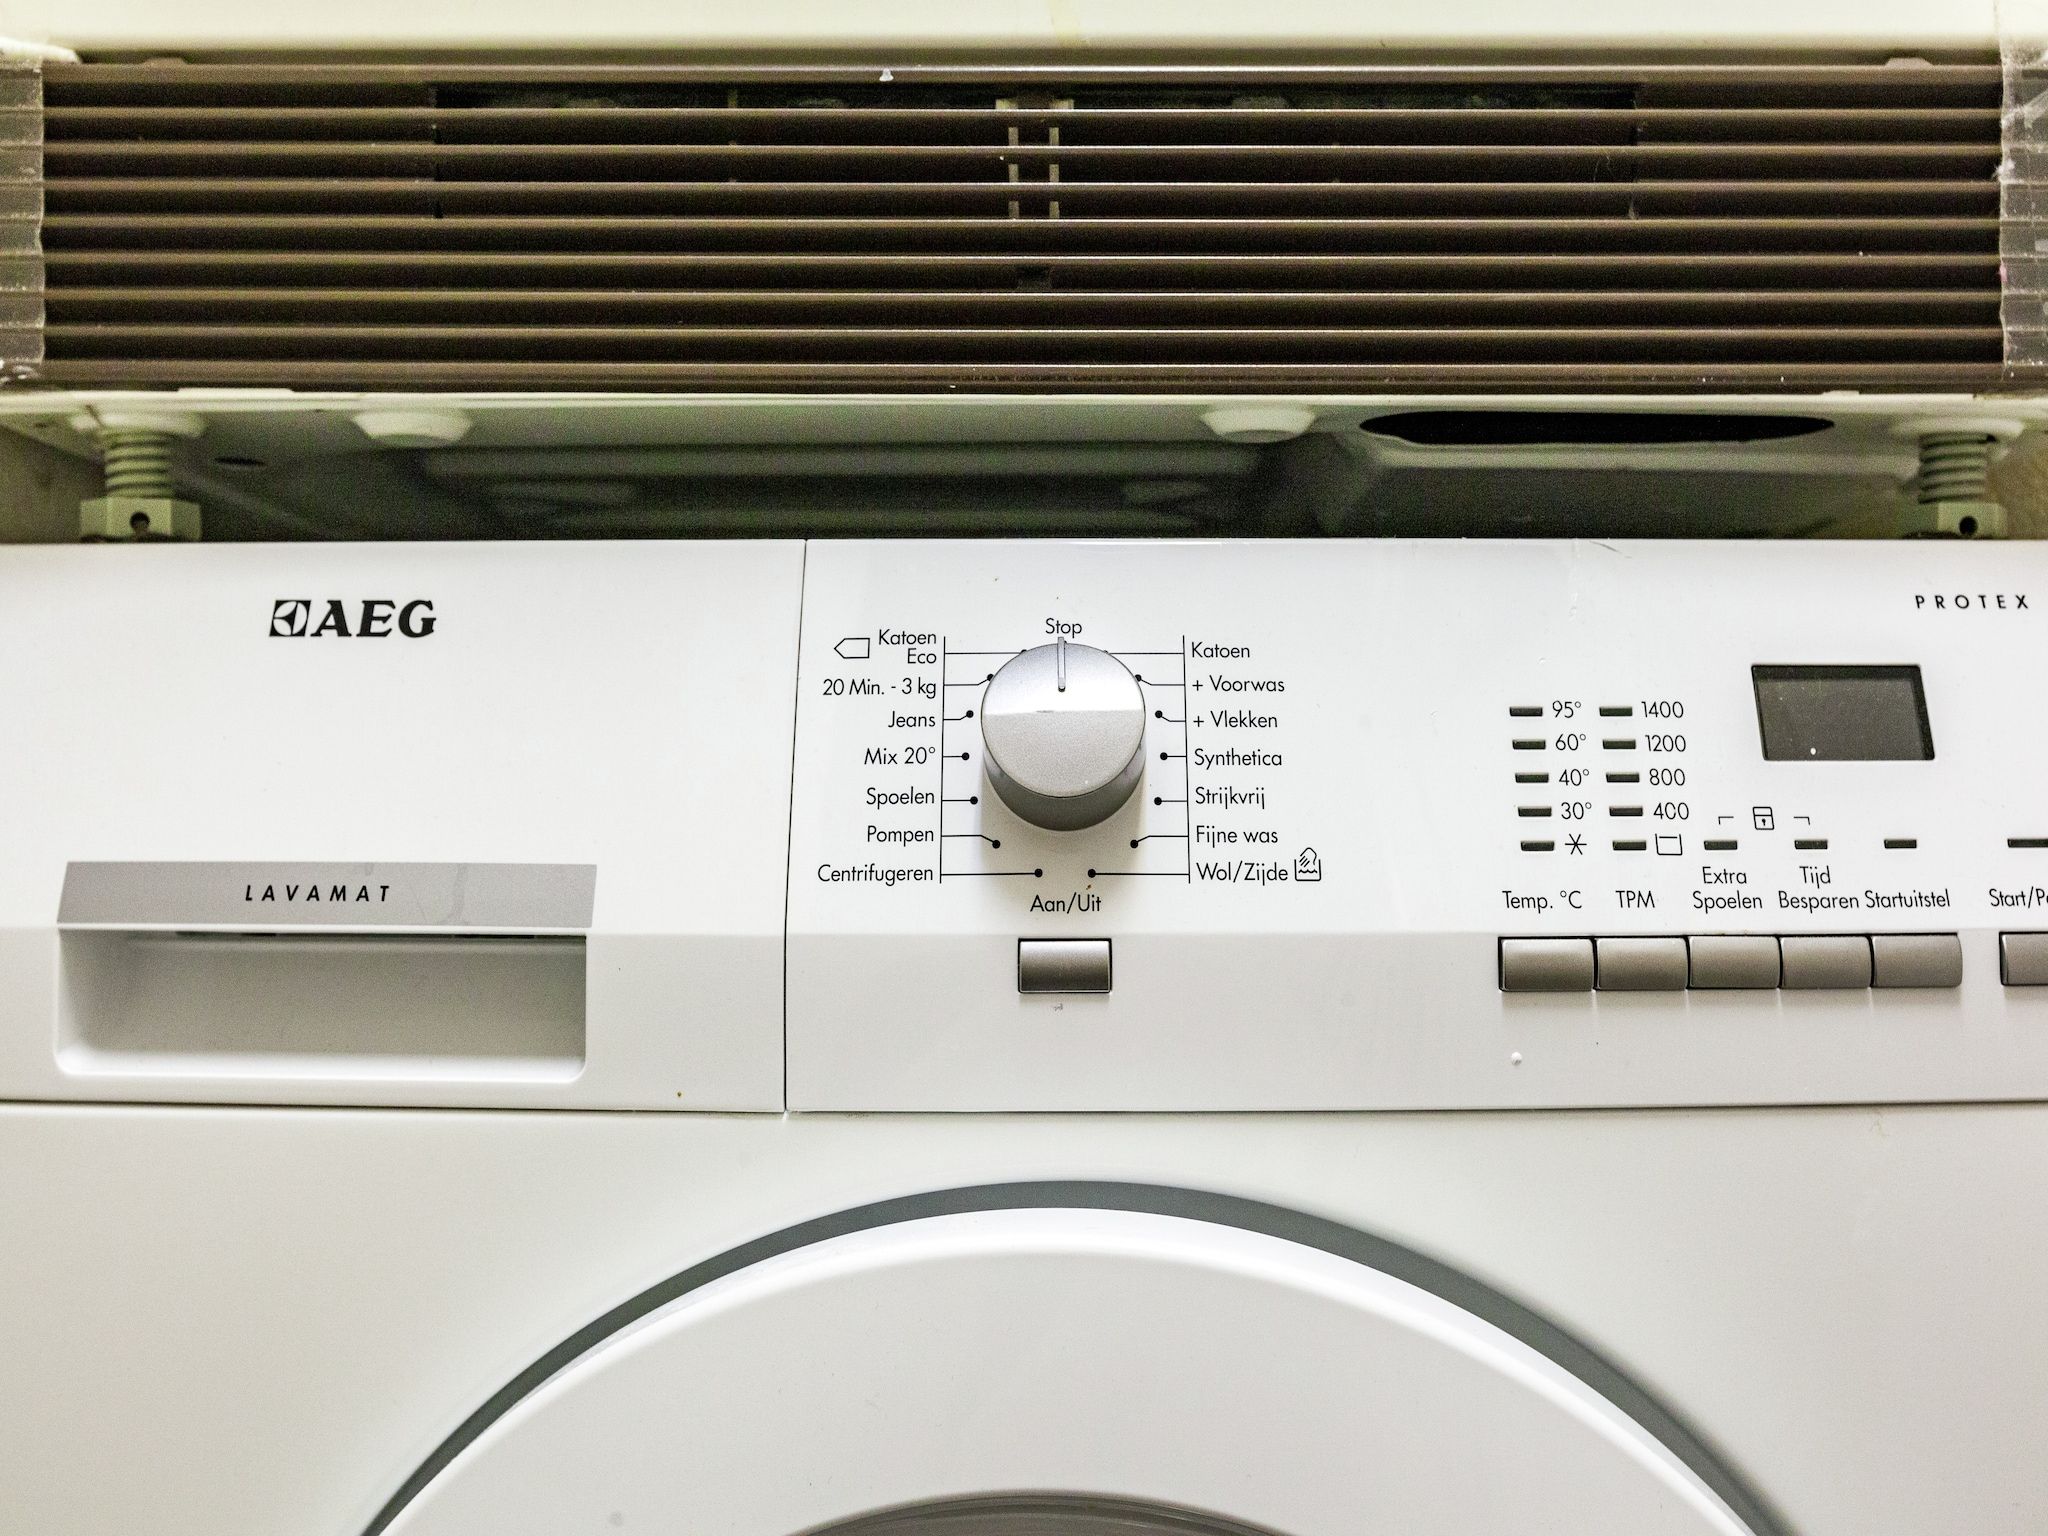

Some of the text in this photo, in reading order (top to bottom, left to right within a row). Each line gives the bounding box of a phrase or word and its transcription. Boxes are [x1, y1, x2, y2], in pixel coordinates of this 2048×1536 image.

[1915, 594, 2028, 609] PROTEX
[311, 600, 436, 638] AEG
[1046, 618, 1082, 638] Stop
[879, 629, 936, 645] Katoen
[907, 648, 937, 664] Eco
[1192, 642, 1250, 658] Katoen
[823, 679, 844, 695] 20
[849, 678, 884, 695] Min.
[902, 678, 912, 694] 3
[918, 677, 936, 699] kg
[1192, 675, 1284, 692] + Voorwas
[1552, 700, 1581, 718] 95°
[1641, 701, 1683, 718] 1400
[888, 711, 935, 728] Jeans
[1193, 710, 1277, 728] + Vlekken
[1556, 734, 1586, 751] 60°
[1645, 735, 1686, 752] 1200
[864, 747, 935, 765] Mix 20°
[1195, 748, 1282, 770] Synthetica
[1559, 769, 1589, 786] 40°
[1649, 768, 1685, 786] 800
[866, 786, 934, 810] Spoelen
[1196, 786, 1264, 809] Strijkvrij
[1561, 802, 1592, 820] 30°
[1653, 802, 1689, 820] 400
[868, 825, 934, 847] Pompen
[1197, 825, 1278, 848] Fijne was
[818, 863, 933, 886] Centrifugeren
[1196, 861, 1288, 886] Wol/Zijde
[1702, 866, 1747, 884] Extra
[1799, 865, 1831, 888] Tijd
[245, 885, 389, 902] LAVAMAT
[1502, 890, 1582, 914] Temp. °C
[1615, 890, 1655, 908] TPM
[1693, 890, 1762, 913] Spoelen
[1778, 890, 1859, 913] Besparen
[1865, 889, 1950, 908] Startuitstel
[1989, 888, 2048, 908] Start/P
[1030, 893, 1101, 914] Aan/Uit
